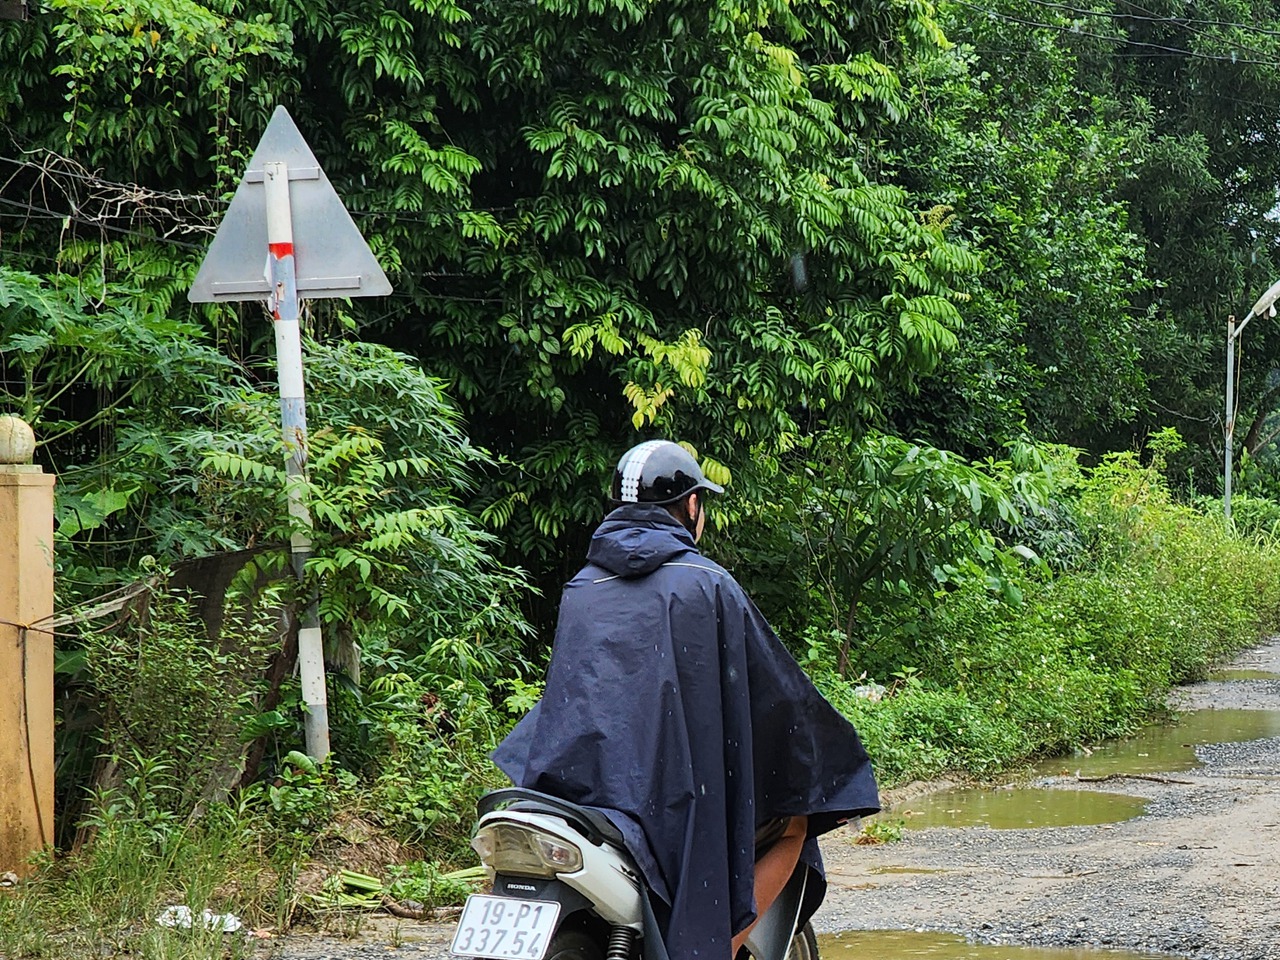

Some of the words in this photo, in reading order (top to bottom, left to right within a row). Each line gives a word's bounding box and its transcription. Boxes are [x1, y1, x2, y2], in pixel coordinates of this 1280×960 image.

[506, 883, 537, 891] HONDA
[481, 900, 543, 929] 19-P1
[458, 926, 542, 958] 337.54
